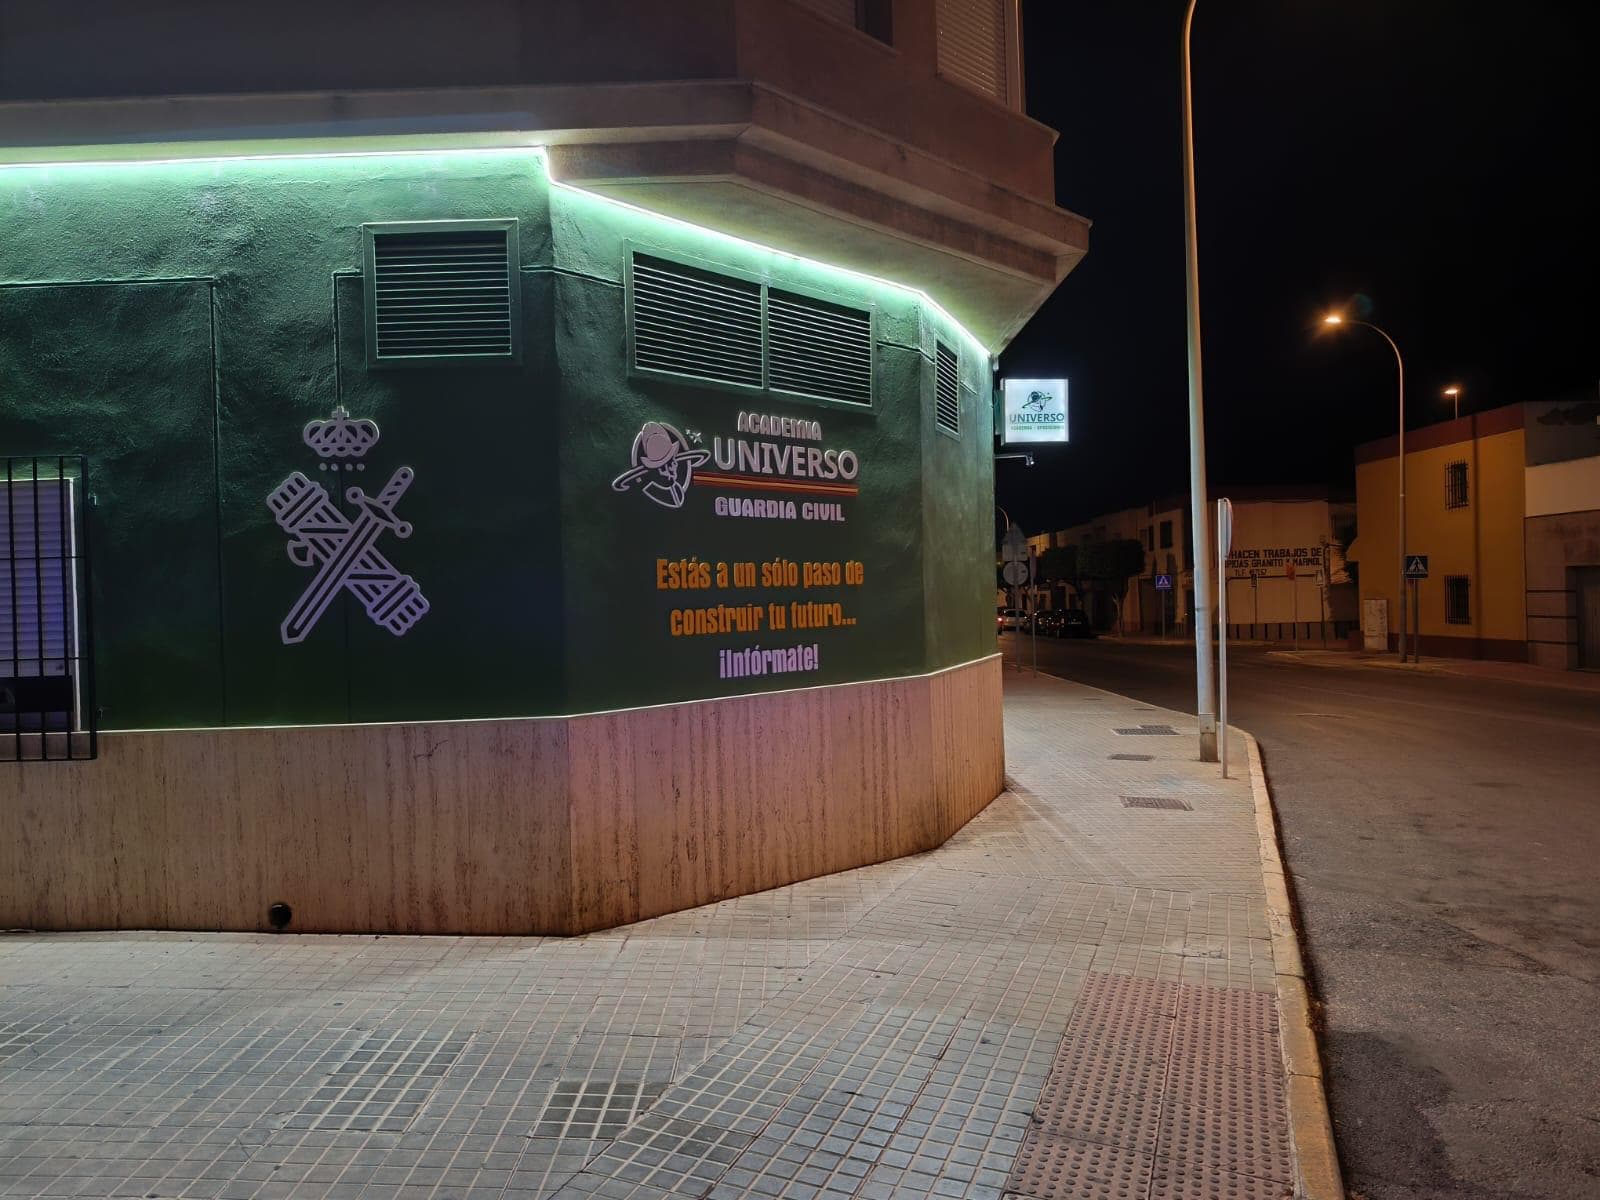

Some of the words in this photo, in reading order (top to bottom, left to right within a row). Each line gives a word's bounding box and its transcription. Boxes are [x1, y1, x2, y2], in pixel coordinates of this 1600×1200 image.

[737, 411, 822, 441] ACADEMIA
[1009, 413, 1065, 423] UNIVERSO
[713, 436, 859, 480] UNIVERSO
[715, 497, 797, 520] GUARDIA
[802, 502, 846, 522] CIVIL
[1225, 559, 1249, 568] PIDAS
[1251, 558, 1283, 568] GRANITO
[1231, 550, 1260, 559] HACEN
[1264, 548, 1308, 558] TRABAJOS
[1311, 547, 1322, 557] DE
[656, 557, 711, 590] Estás
[717, 562, 729, 588] a
[734, 562, 757, 587] un
[762, 557, 799, 587] sólo
[803, 561, 840, 588] paso
[846, 559, 865, 586] de
[670, 603, 763, 637] construir
[768, 604, 786, 630] tu
[791, 602, 857, 628] futuro...
[719, 643, 819, 679] ¡Infórmate!
